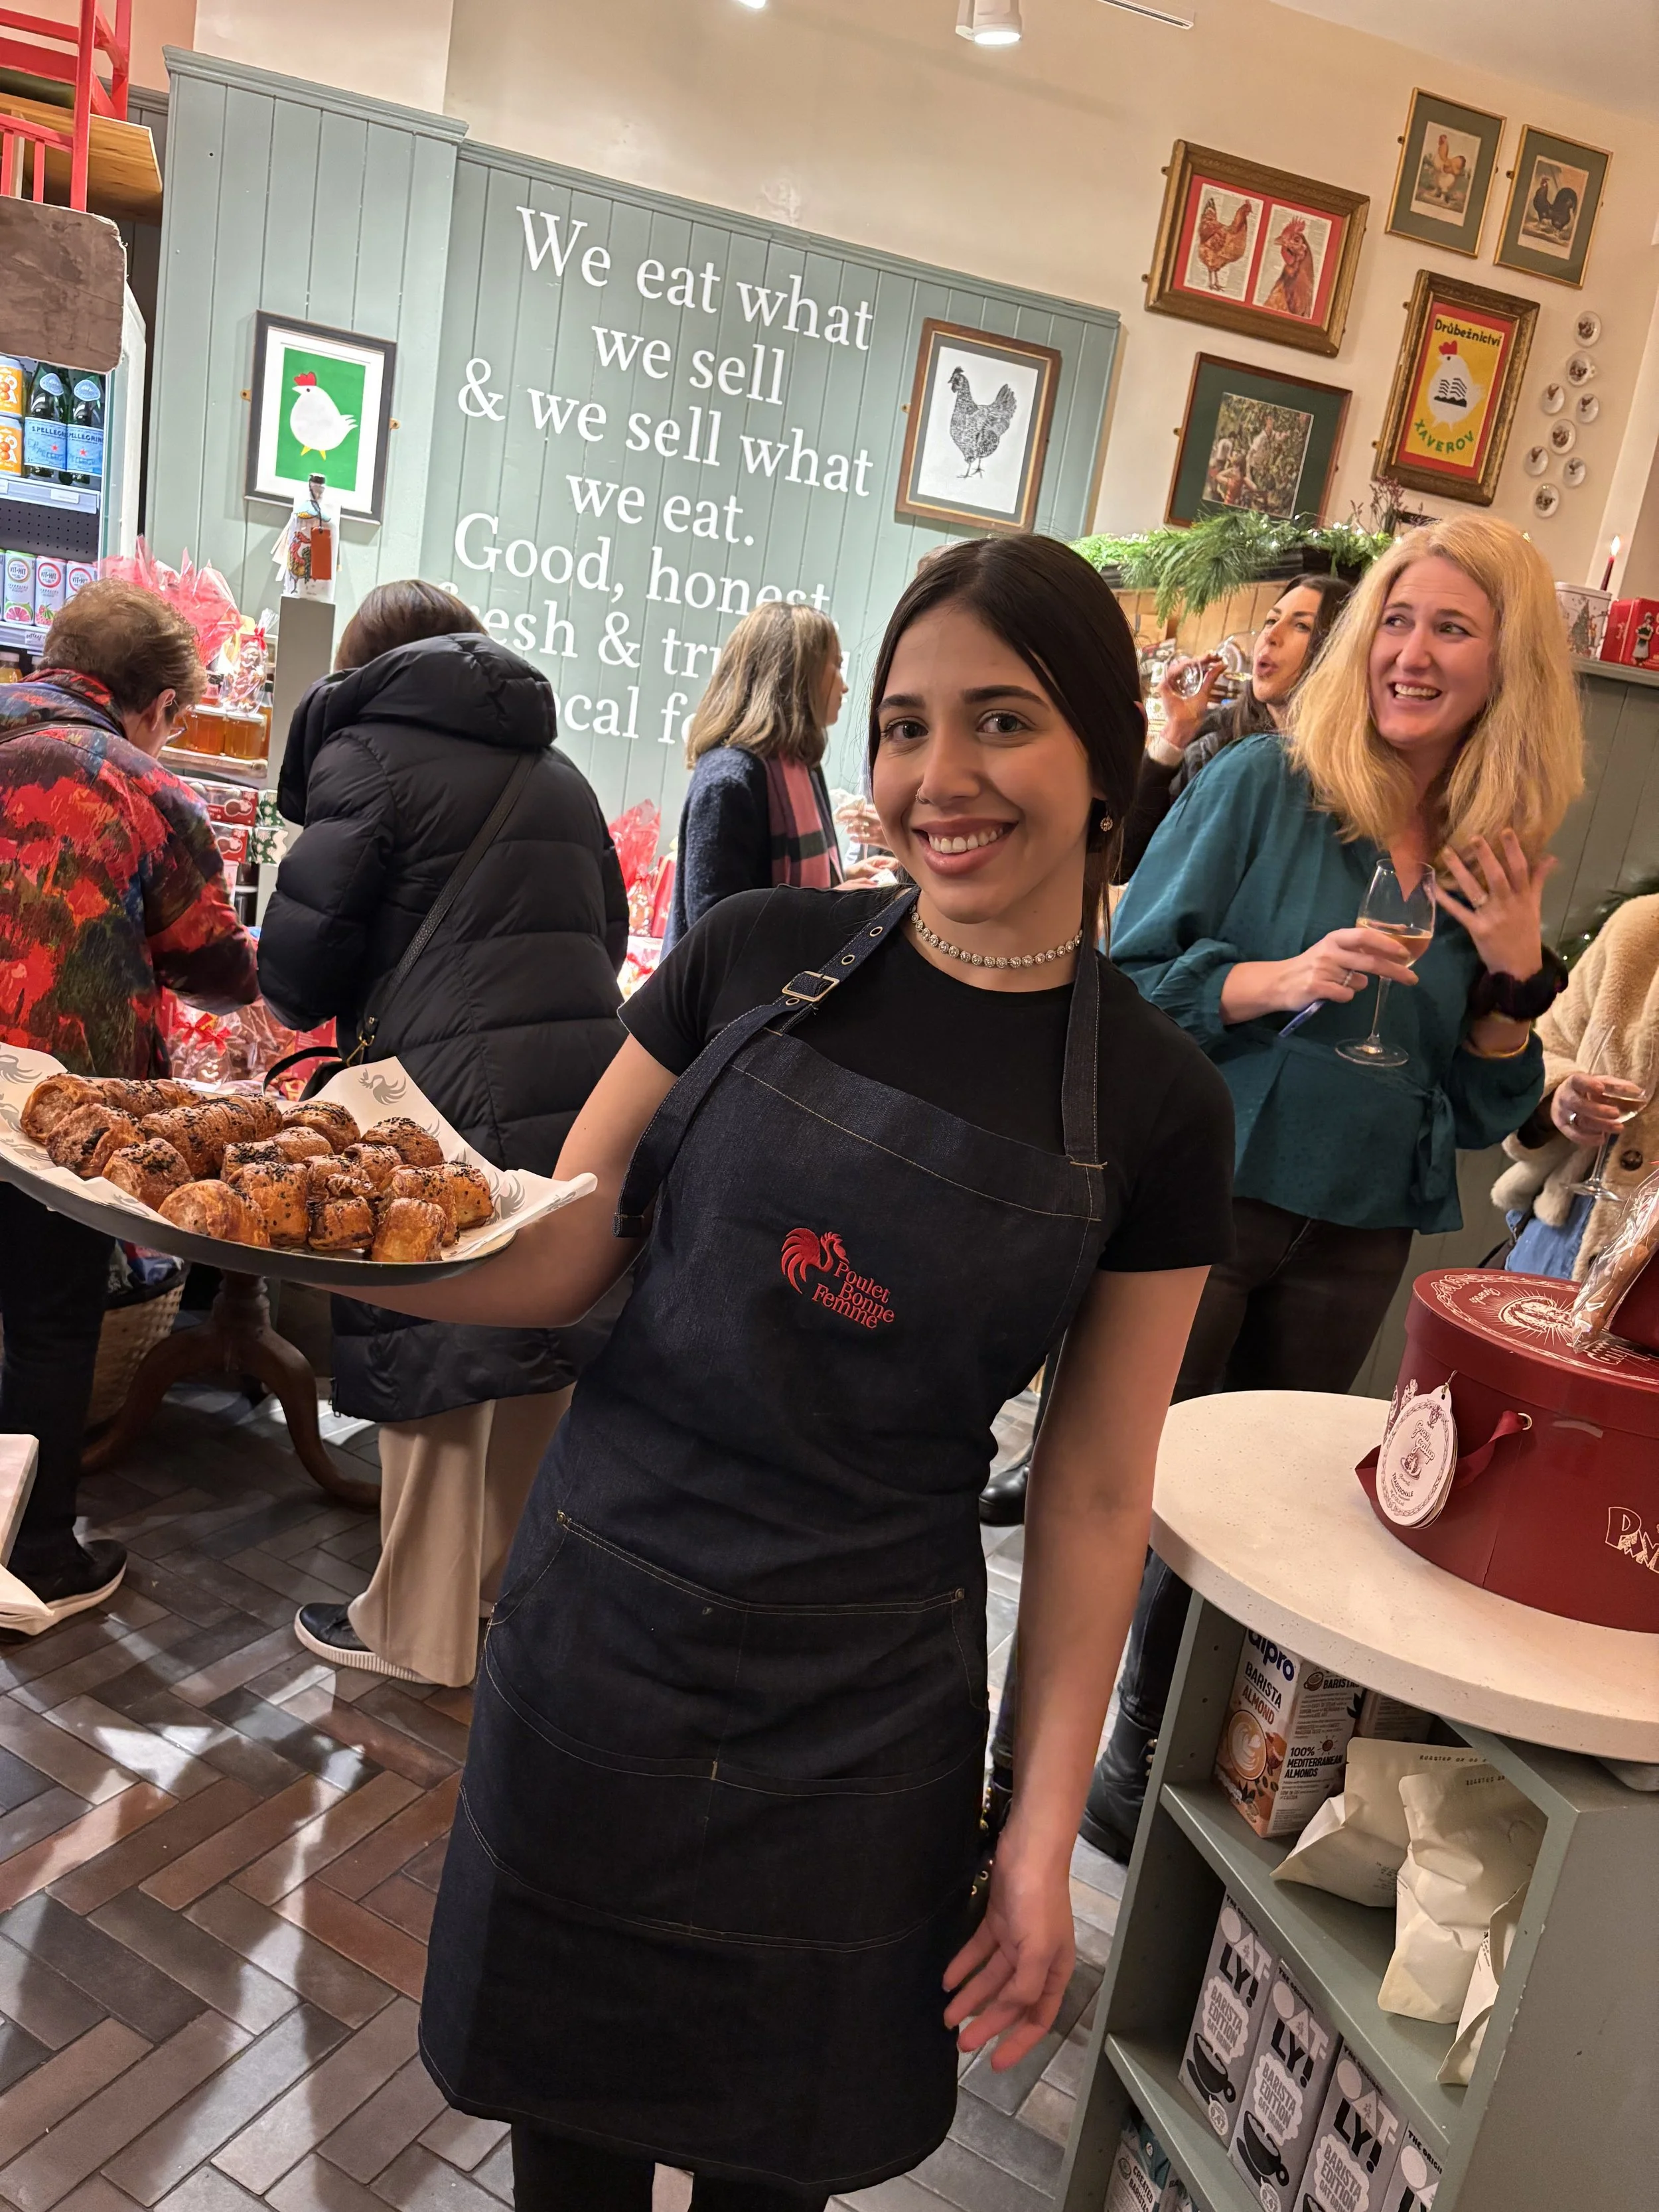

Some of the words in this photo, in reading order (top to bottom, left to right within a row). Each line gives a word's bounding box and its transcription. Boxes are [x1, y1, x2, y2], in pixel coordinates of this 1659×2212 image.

[516, 205, 611, 287] We
[637, 259, 719, 313] eat
[737, 274, 873, 350] what
[591, 325, 671, 379] we
[689, 344, 784, 405] sell
[458, 358, 505, 421] &
[528, 388, 606, 441] we
[625, 406, 721, 466] sell
[739, 428, 873, 496] what
[1414, 419, 1474, 454] XAVEROV
[566, 475, 644, 524] we
[663, 496, 755, 546] eat.
[455, 513, 624, 603] Good,
[598, 611, 640, 668] &
[834, 1261, 891, 1303] Poulet
[838, 1281, 895, 1323] Bonne
[812, 1283, 878, 1329] Femme
[1392, 1473, 1413, 1497] TRADIZIONALE
[1242, 1685, 1275, 1725] ALMOND
[1245, 1661, 1282, 1708] BARISTA
[1285, 1768, 1319, 1779] ALMONDS
[1287, 1755, 1343, 1768] MEDITERRANEAN
[1290, 1747, 1315, 1757] 100%
[1219, 1943, 1259, 2008] LY!
[1206, 2018, 1217, 2037] OAT
[1208, 2003, 1238, 2047] EDITION
[1210, 1985, 1242, 2034] BARISTA
[1271, 2018, 1314, 2088] LY!
[1258, 2097, 1269, 2116] OAT
[1261, 2078, 1292, 2129] EDITION
[1262, 2062, 1297, 2116] BARISTA
[1333, 2098, 1382, 2174] LY!
[1408, 2130, 1421, 2150] THE
[1133, 2166, 1153, 2204] CREATED
[1319, 2180, 1331, 2201] OAT
[1321, 2161, 1357, 2212] EDITION
[1324, 2143, 1362, 2203] BARISTA
